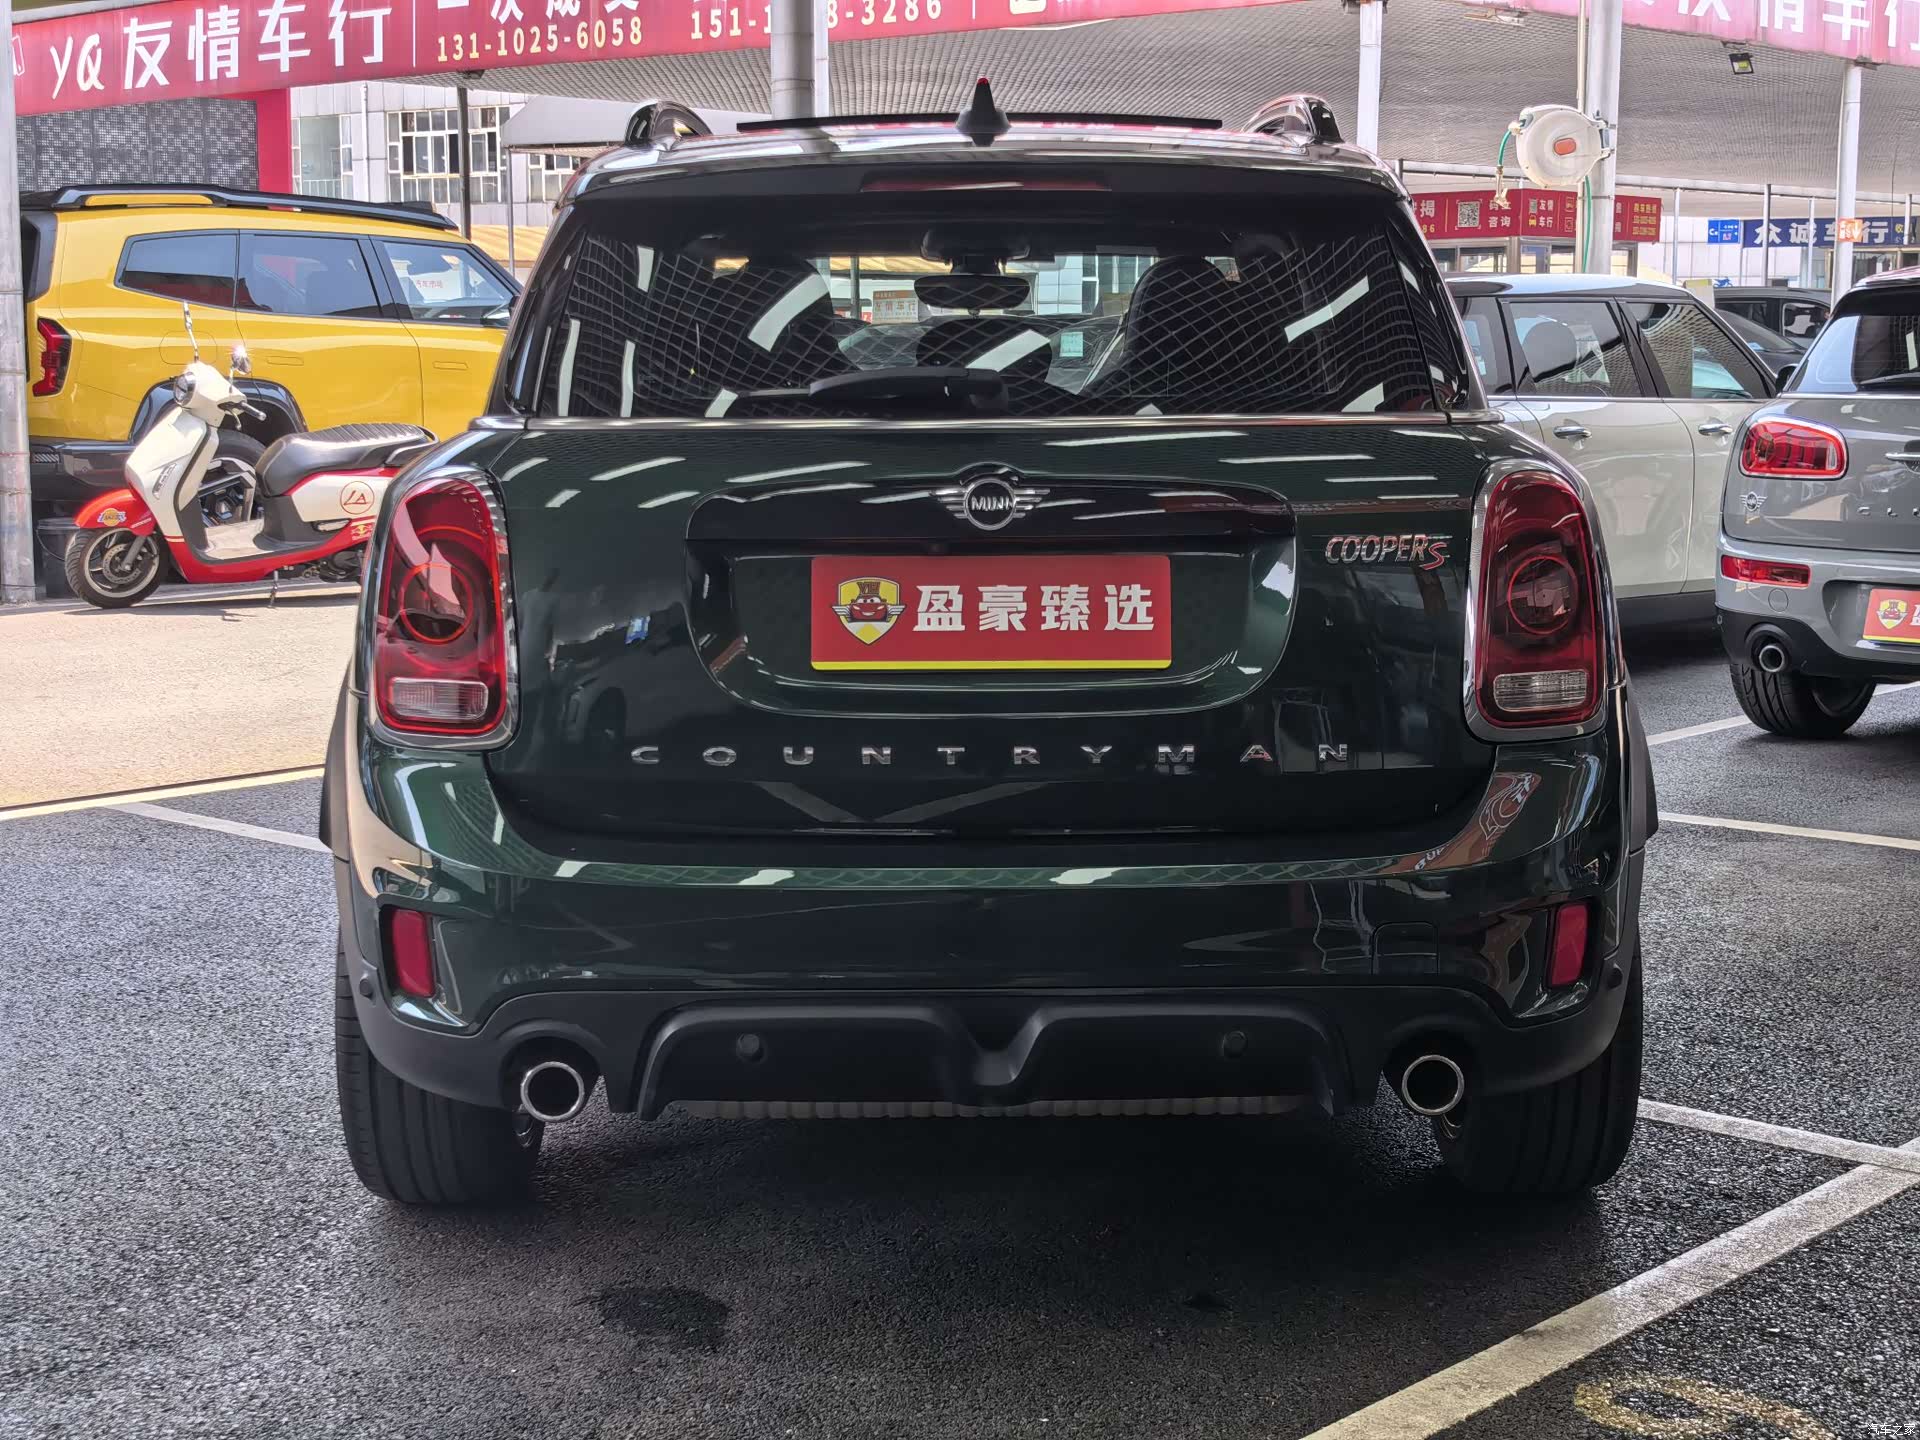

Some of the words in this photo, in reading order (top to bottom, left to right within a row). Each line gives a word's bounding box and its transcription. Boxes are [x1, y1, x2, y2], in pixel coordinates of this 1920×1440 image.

[691, 0, 942, 39] 151-18-3286
[123, 0, 392, 90] 友情车行
[438, 16, 642, 62] 131-1025-6058
[1488, 216, 1511, 228] 咨询
[1538, 215, 1554, 228] 车行
[970, 496, 1013, 511] MINI
[913, 585, 1155, 632] 盈豪臻选
[631, 744, 1348, 767] COUNTRYMAN
